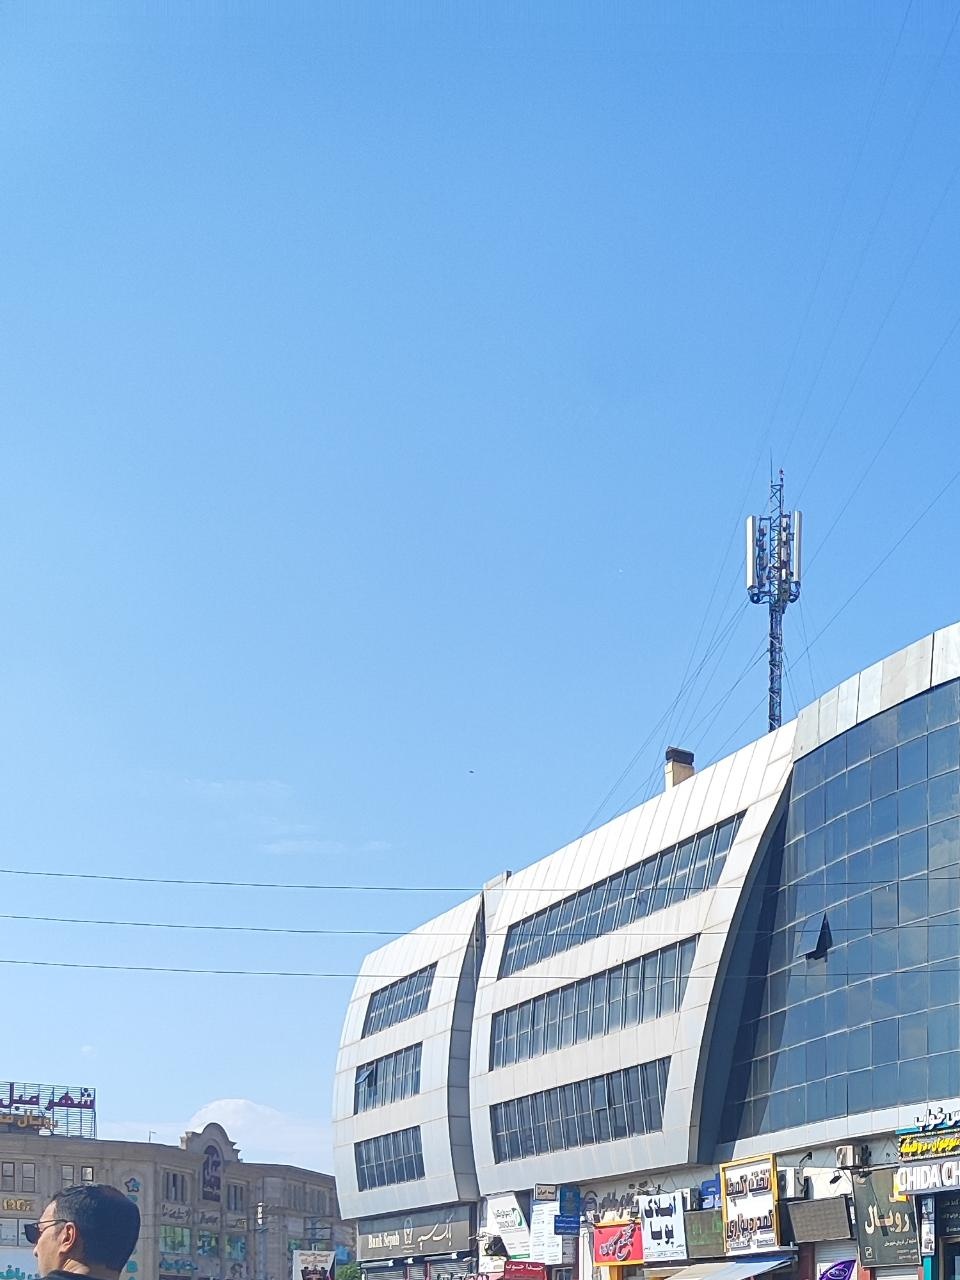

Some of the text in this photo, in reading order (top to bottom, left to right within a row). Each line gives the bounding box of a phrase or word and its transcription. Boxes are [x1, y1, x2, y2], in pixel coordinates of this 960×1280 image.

[45, 1087, 95, 1111] شهر
[914, 1107, 944, 1131] خواب
[897, 1164, 941, 1192] CHIDA
[864, 1204, 910, 1235] رویال
[368, 1234, 383, 1248] Bank
[383, 1232, 400, 1249] Sepah
